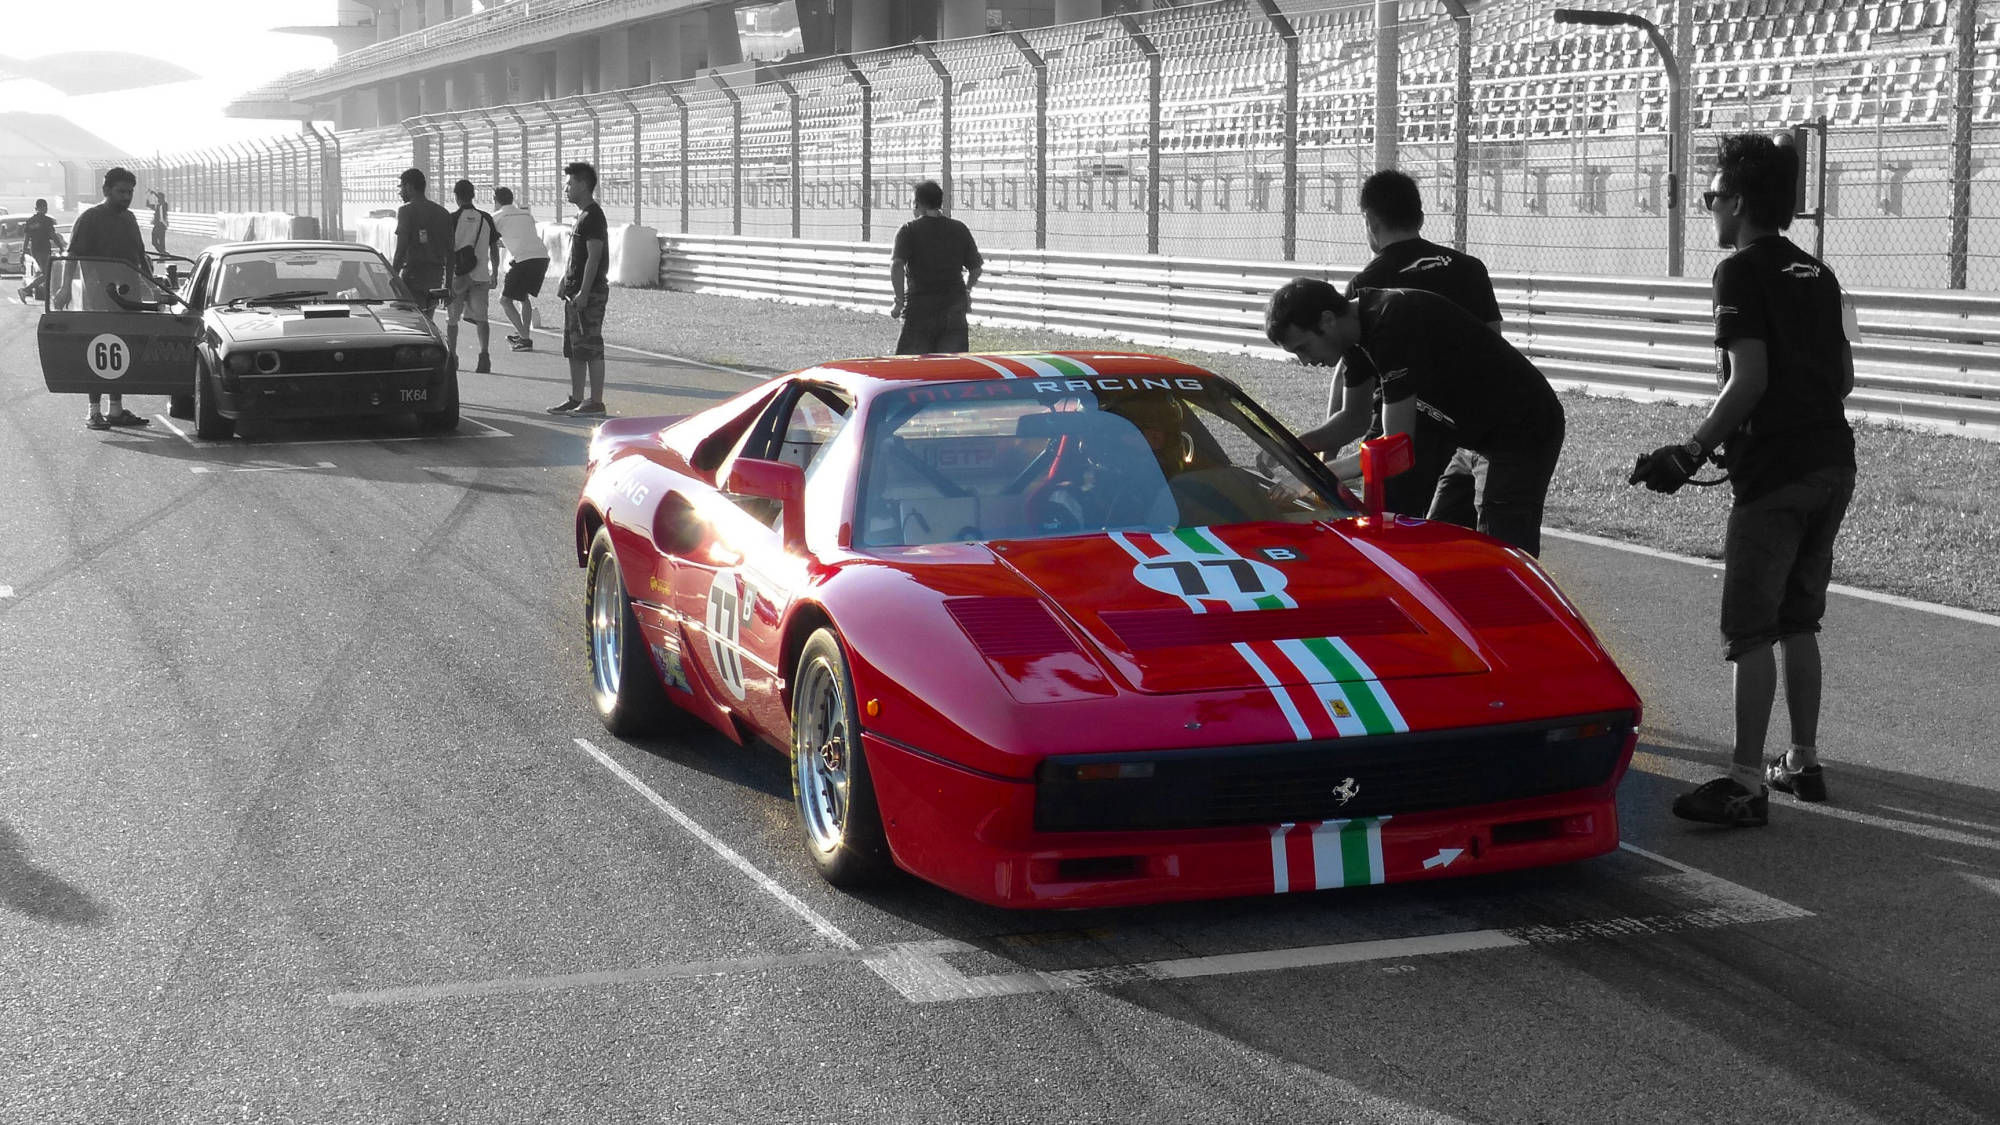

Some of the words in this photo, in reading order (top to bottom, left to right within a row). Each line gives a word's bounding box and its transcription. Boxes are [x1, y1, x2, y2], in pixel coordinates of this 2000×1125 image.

[95, 342, 122, 371] 66
[1033, 378, 1204, 393] RACING
[1263, 548, 1298, 560] B
[1142, 559, 1267, 596] 77
[743, 589, 753, 621] B
[711, 585, 742, 689] 77
